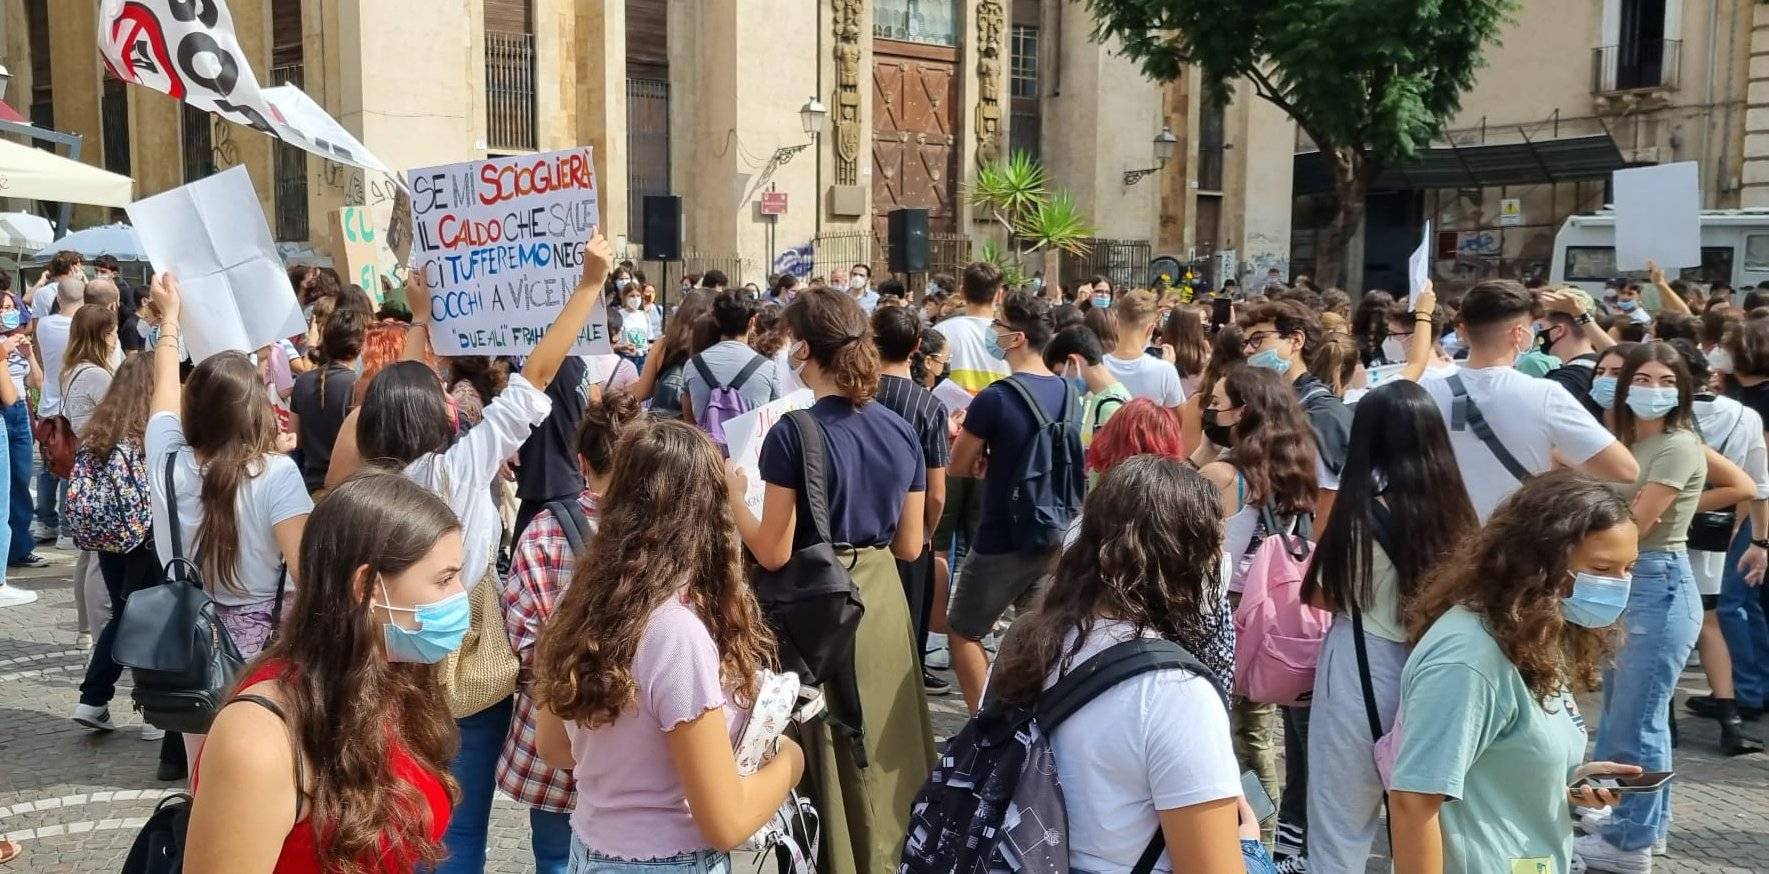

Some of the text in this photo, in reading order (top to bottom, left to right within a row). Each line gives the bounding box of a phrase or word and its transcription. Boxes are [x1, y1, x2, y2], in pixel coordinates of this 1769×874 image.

[413, 173, 448, 215] SE
[438, 214, 502, 251] CALDO
[503, 207, 547, 242] CHE
[548, 199, 597, 240] SALE
[445, 242, 552, 285] TUFFEREMO
[492, 284, 505, 311] A
[511, 326, 544, 349] FRAH
